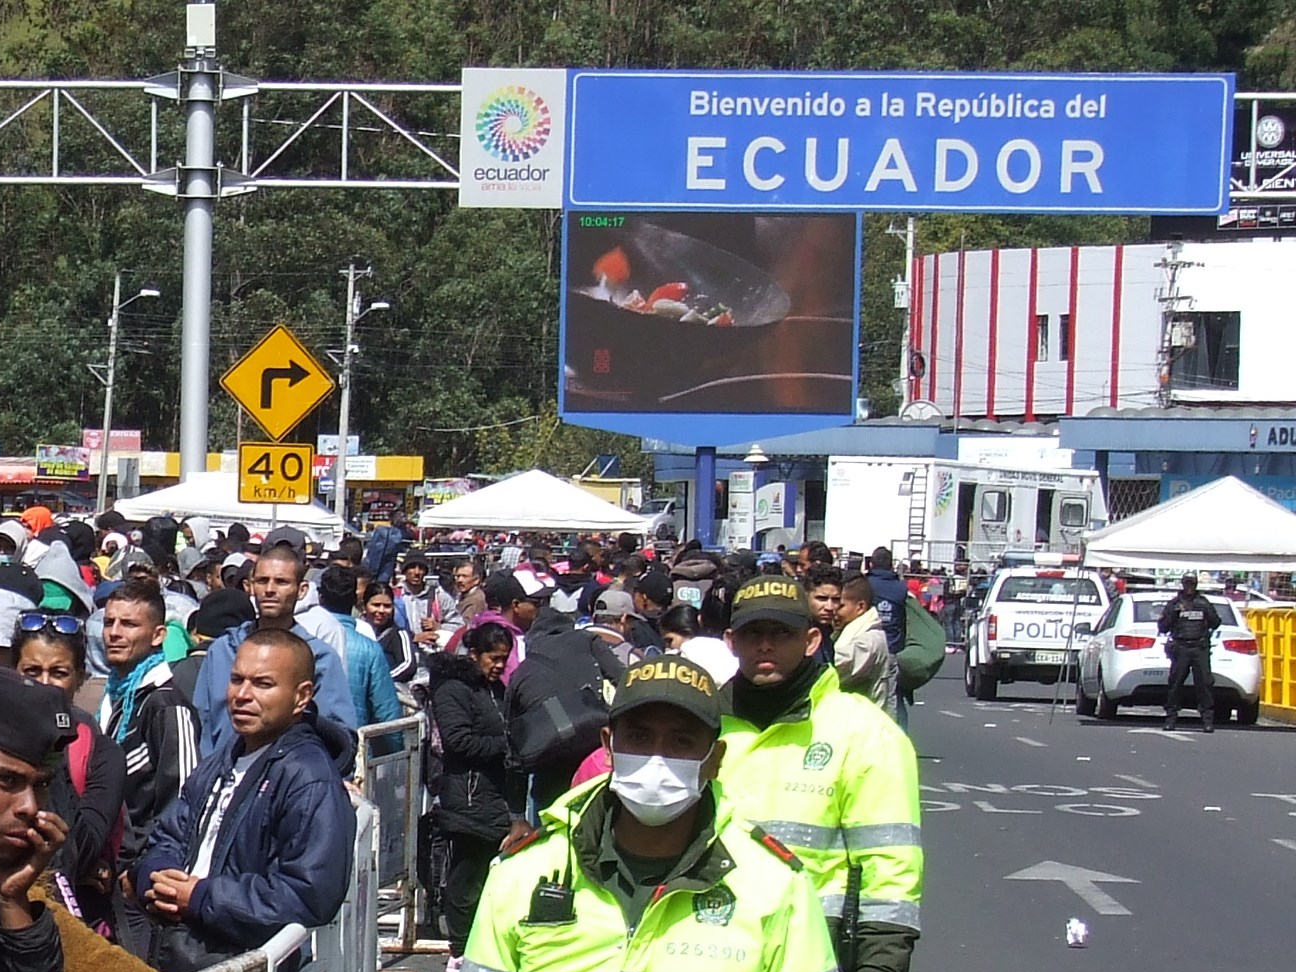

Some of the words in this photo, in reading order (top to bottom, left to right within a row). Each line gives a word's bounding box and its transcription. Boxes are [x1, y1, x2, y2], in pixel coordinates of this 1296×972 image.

[689, 90, 846, 117] Bienvenido
[855, 97, 872, 117] a
[880, 91, 904, 117] la
[915, 91, 1055, 124] República
[1065, 93, 1107, 119] del
[473, 164, 550, 182] ecuador
[686, 136, 1105, 194] ECUADOR
[579, 216, 625, 228] 10:04:17
[247, 452, 304, 482] 40
[253, 486, 296, 499] km/h
[733, 581, 798, 605] POLICIA
[626, 662, 712, 697] POLICIA
